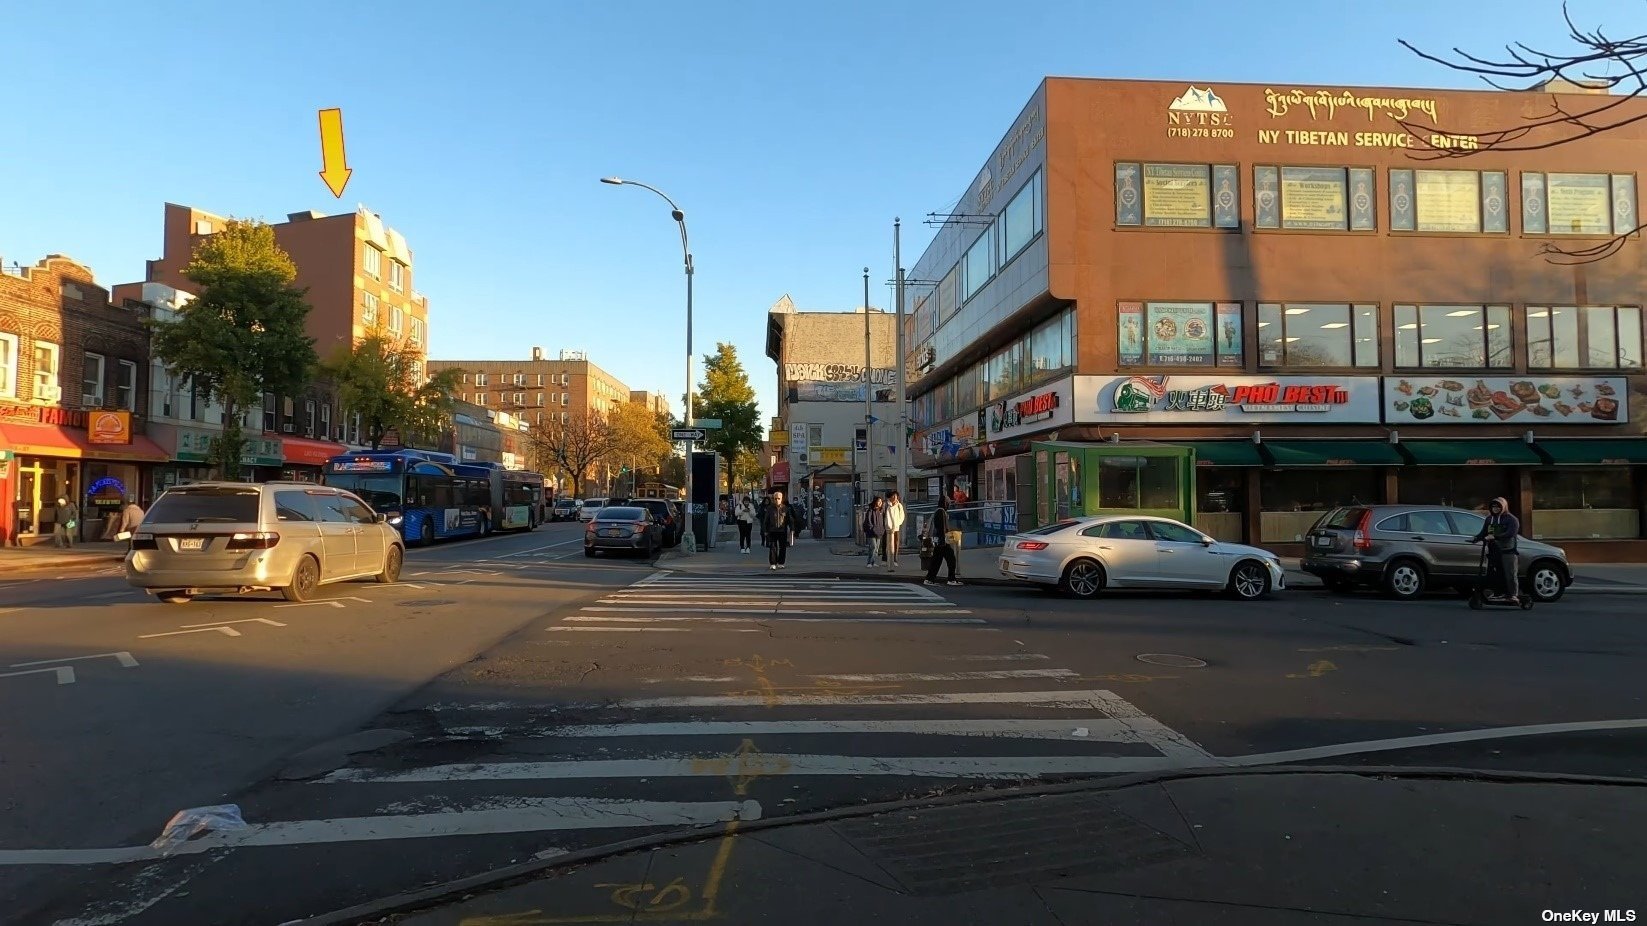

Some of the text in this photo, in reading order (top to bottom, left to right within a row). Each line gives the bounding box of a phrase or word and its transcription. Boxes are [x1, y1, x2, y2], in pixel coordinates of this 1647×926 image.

[1168, 128, 1234, 138] (718) 278 8700
[1258, 130, 1280, 144] NY
[1286, 131, 1348, 146] TIBETAN
[1355, 133, 1414, 148] SERVICE
[1034, 392, 1052, 413] BEST
[1283, 385, 1341, 404] BEST
